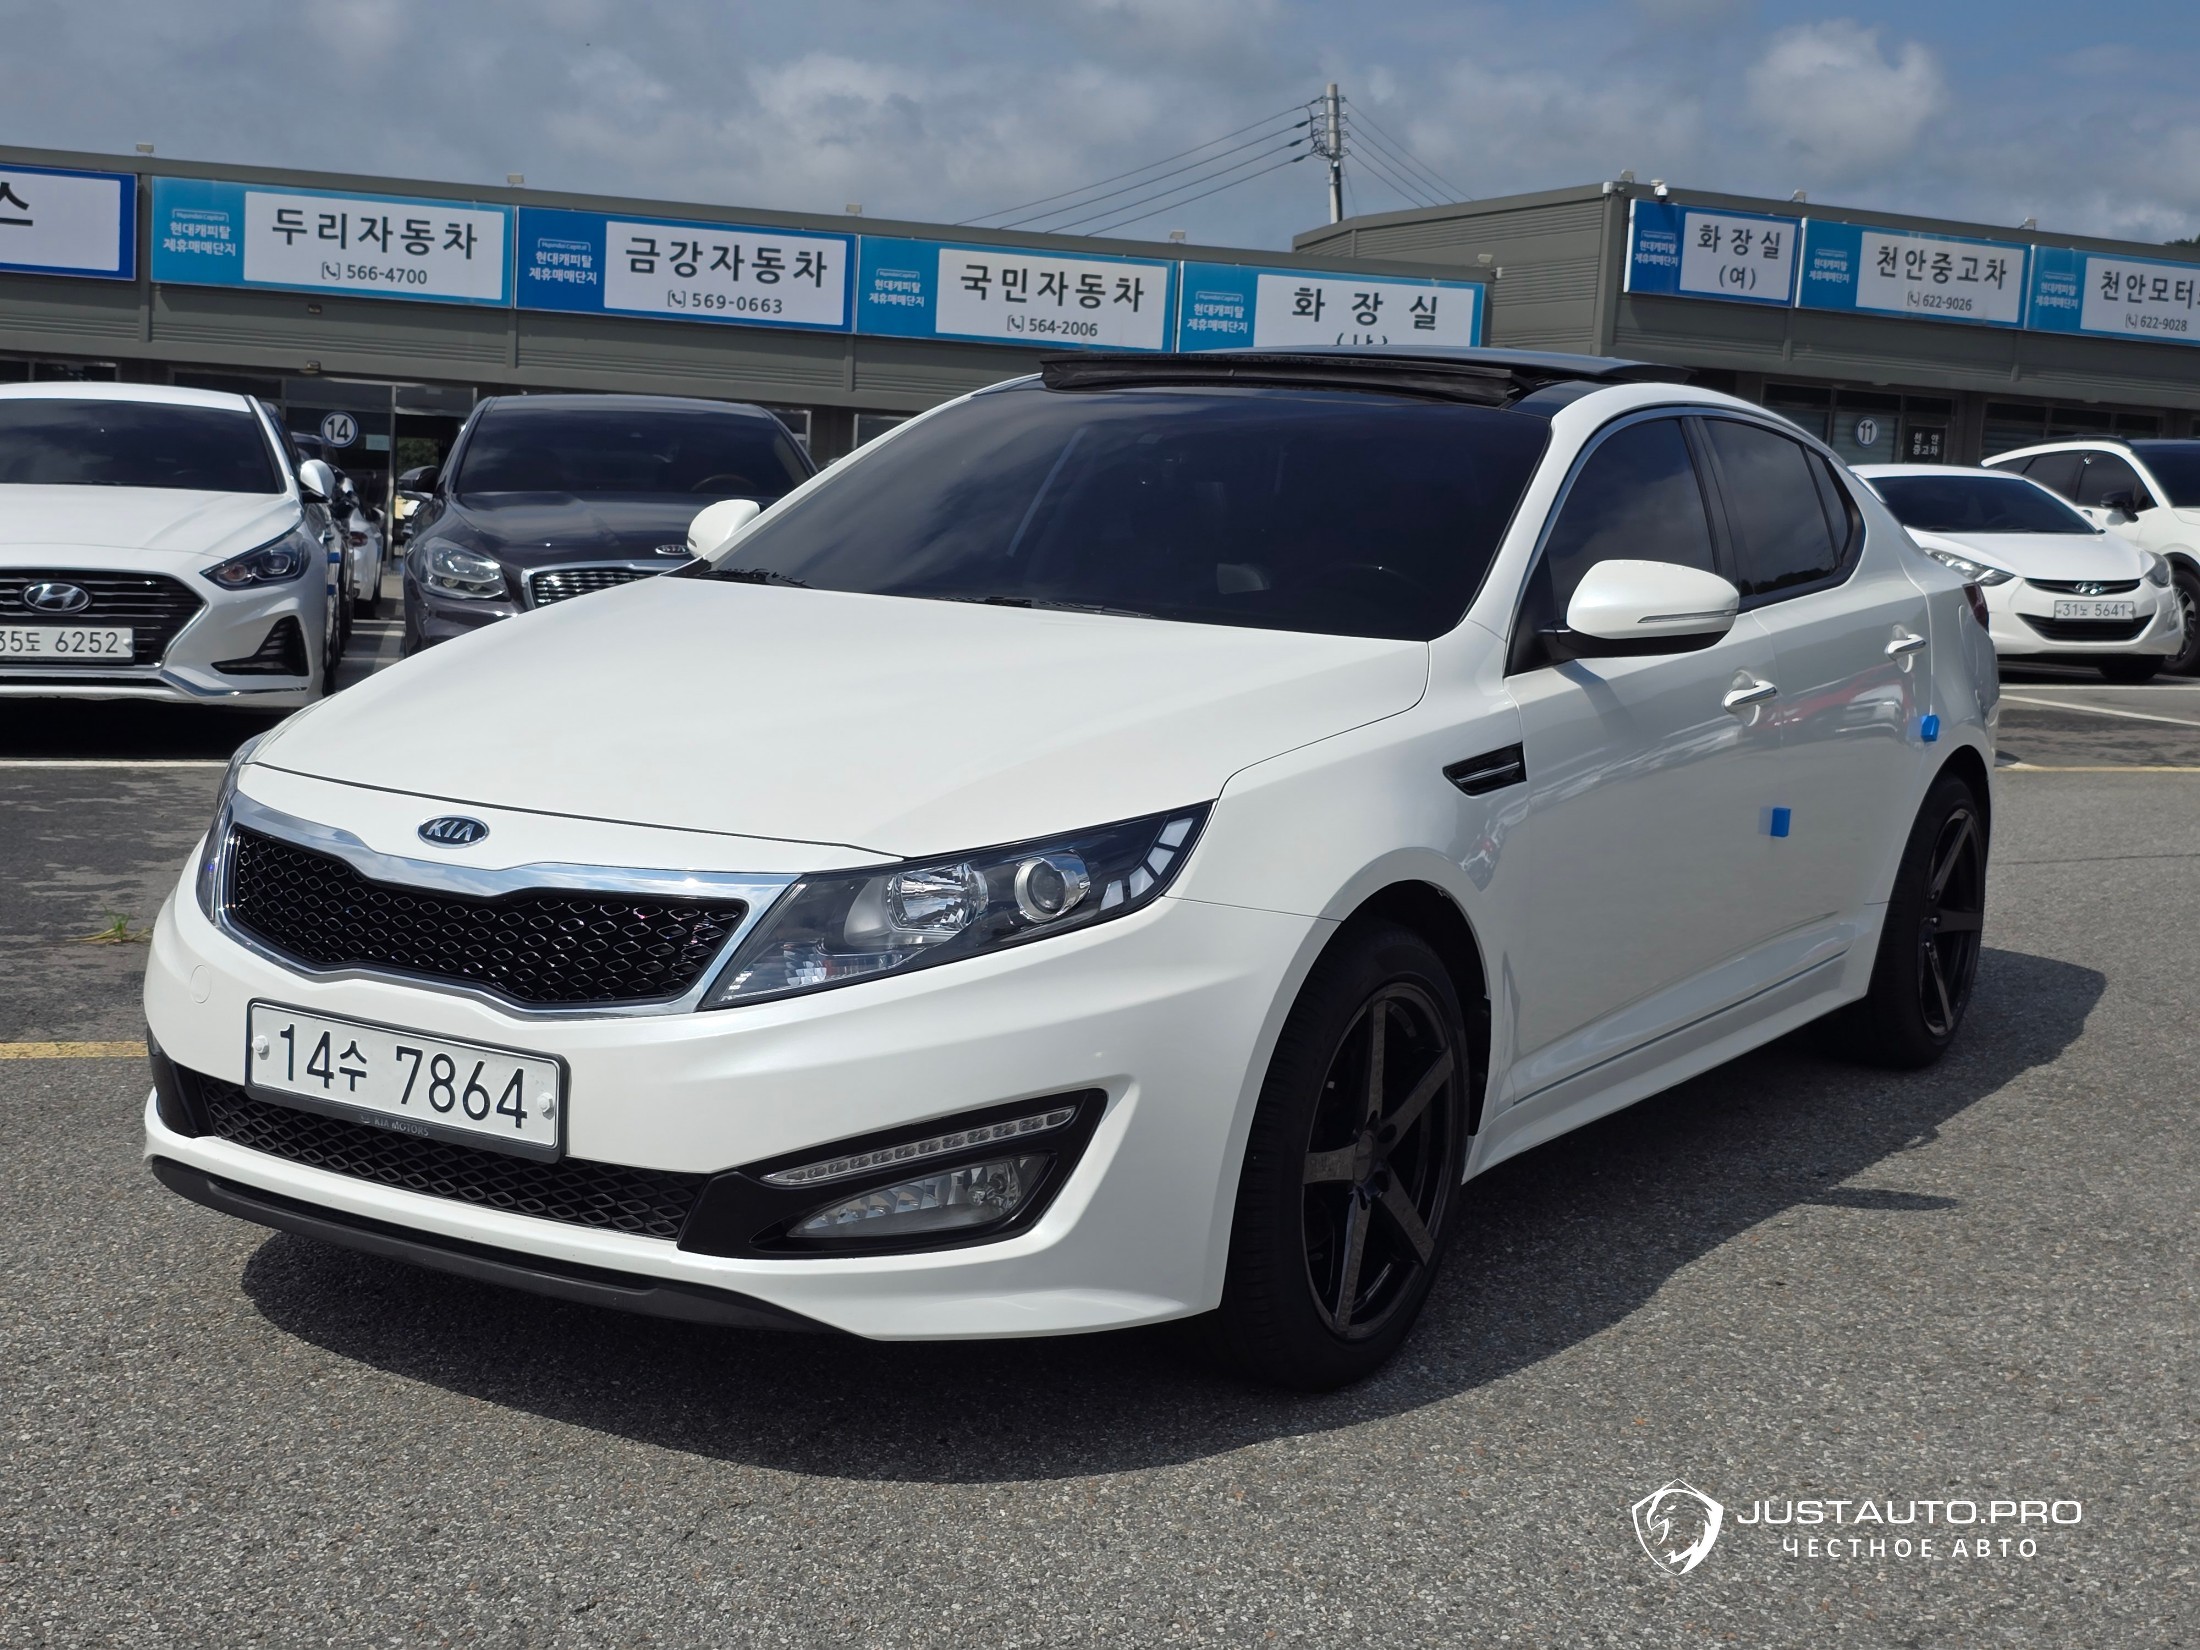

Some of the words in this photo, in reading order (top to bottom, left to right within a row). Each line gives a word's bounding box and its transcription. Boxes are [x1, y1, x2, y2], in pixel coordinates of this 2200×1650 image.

[170, 221, 232, 240] 현대캐피탈
[272, 207, 478, 260] 두리자동차
[162, 237, 236, 257] 제휴매매단지
[535, 250, 593, 268] 현대캐피탈
[625, 237, 828, 288] 금강자동차
[1877, 245, 2007, 290] 천안중고차
[346, 263, 428, 286] 566-4700
[528, 266, 598, 286] 제휴매매단지
[1718, 265, 1756, 290] (여)
[960, 264, 1145, 313] 국민자동차
[2101, 270, 2200, 310] 천안모터
[691, 292, 783, 315] 569-0663
[1922, 294, 1973, 312] 622-9026
[1028, 317, 1098, 337] 564-2006
[2140, 315, 2188, 333] 622-9028
[327, 417, 350, 442] 14
[1860, 422, 1873, 444] 11
[2094, 604, 2126, 617] 5641
[55, 631, 118, 654] 6252
[426, 819, 476, 842] KIA
[279, 1023, 368, 1092] 14수
[396, 1045, 528, 1129] 7864
[374, 1117, 390, 1128] KIA
[391, 1121, 429, 1137] MOTORS
